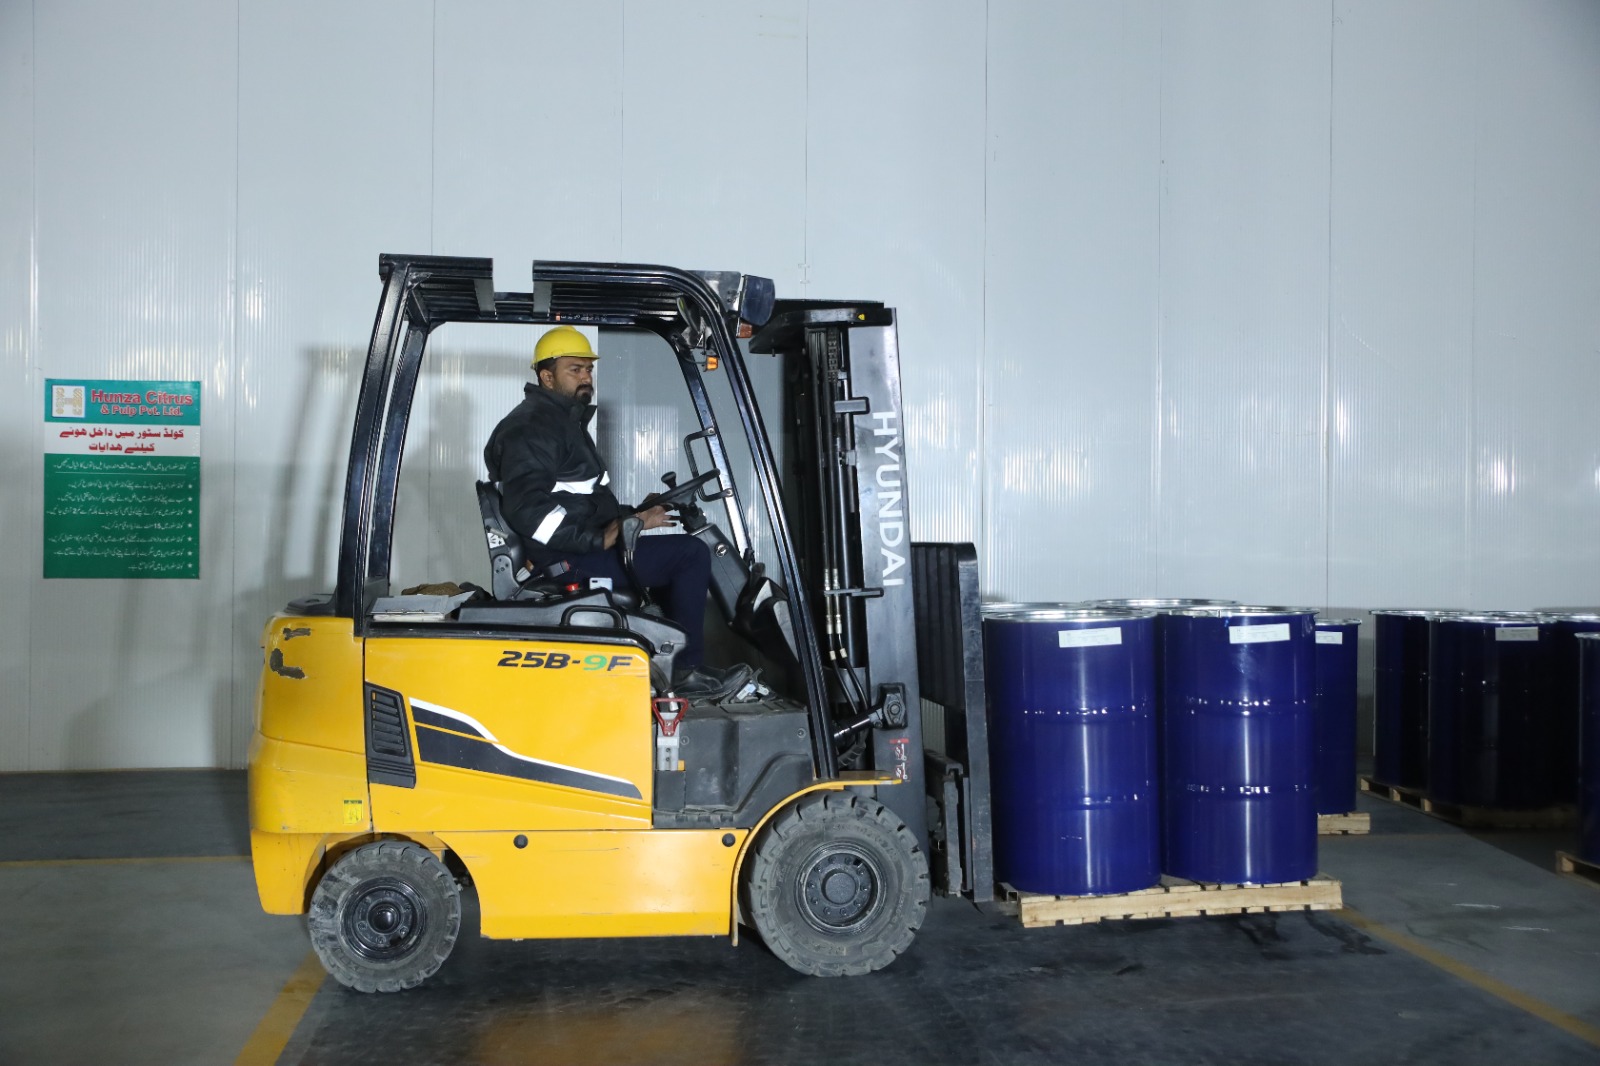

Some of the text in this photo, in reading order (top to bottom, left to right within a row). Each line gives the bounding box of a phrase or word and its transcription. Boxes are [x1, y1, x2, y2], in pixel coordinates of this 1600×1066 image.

[91, 389, 193, 406] Hunza Citrus
[101, 405, 183, 417] & Pulp Pvt. Ltd.
[89, 429, 113, 439] داخل
[115, 430, 135, 439] میں
[137, 429, 161, 440] سٹور
[163, 428, 184, 439] کولڈ
[872, 411, 906, 586] HYUNDAI
[497, 650, 633, 671] 25B-9F
